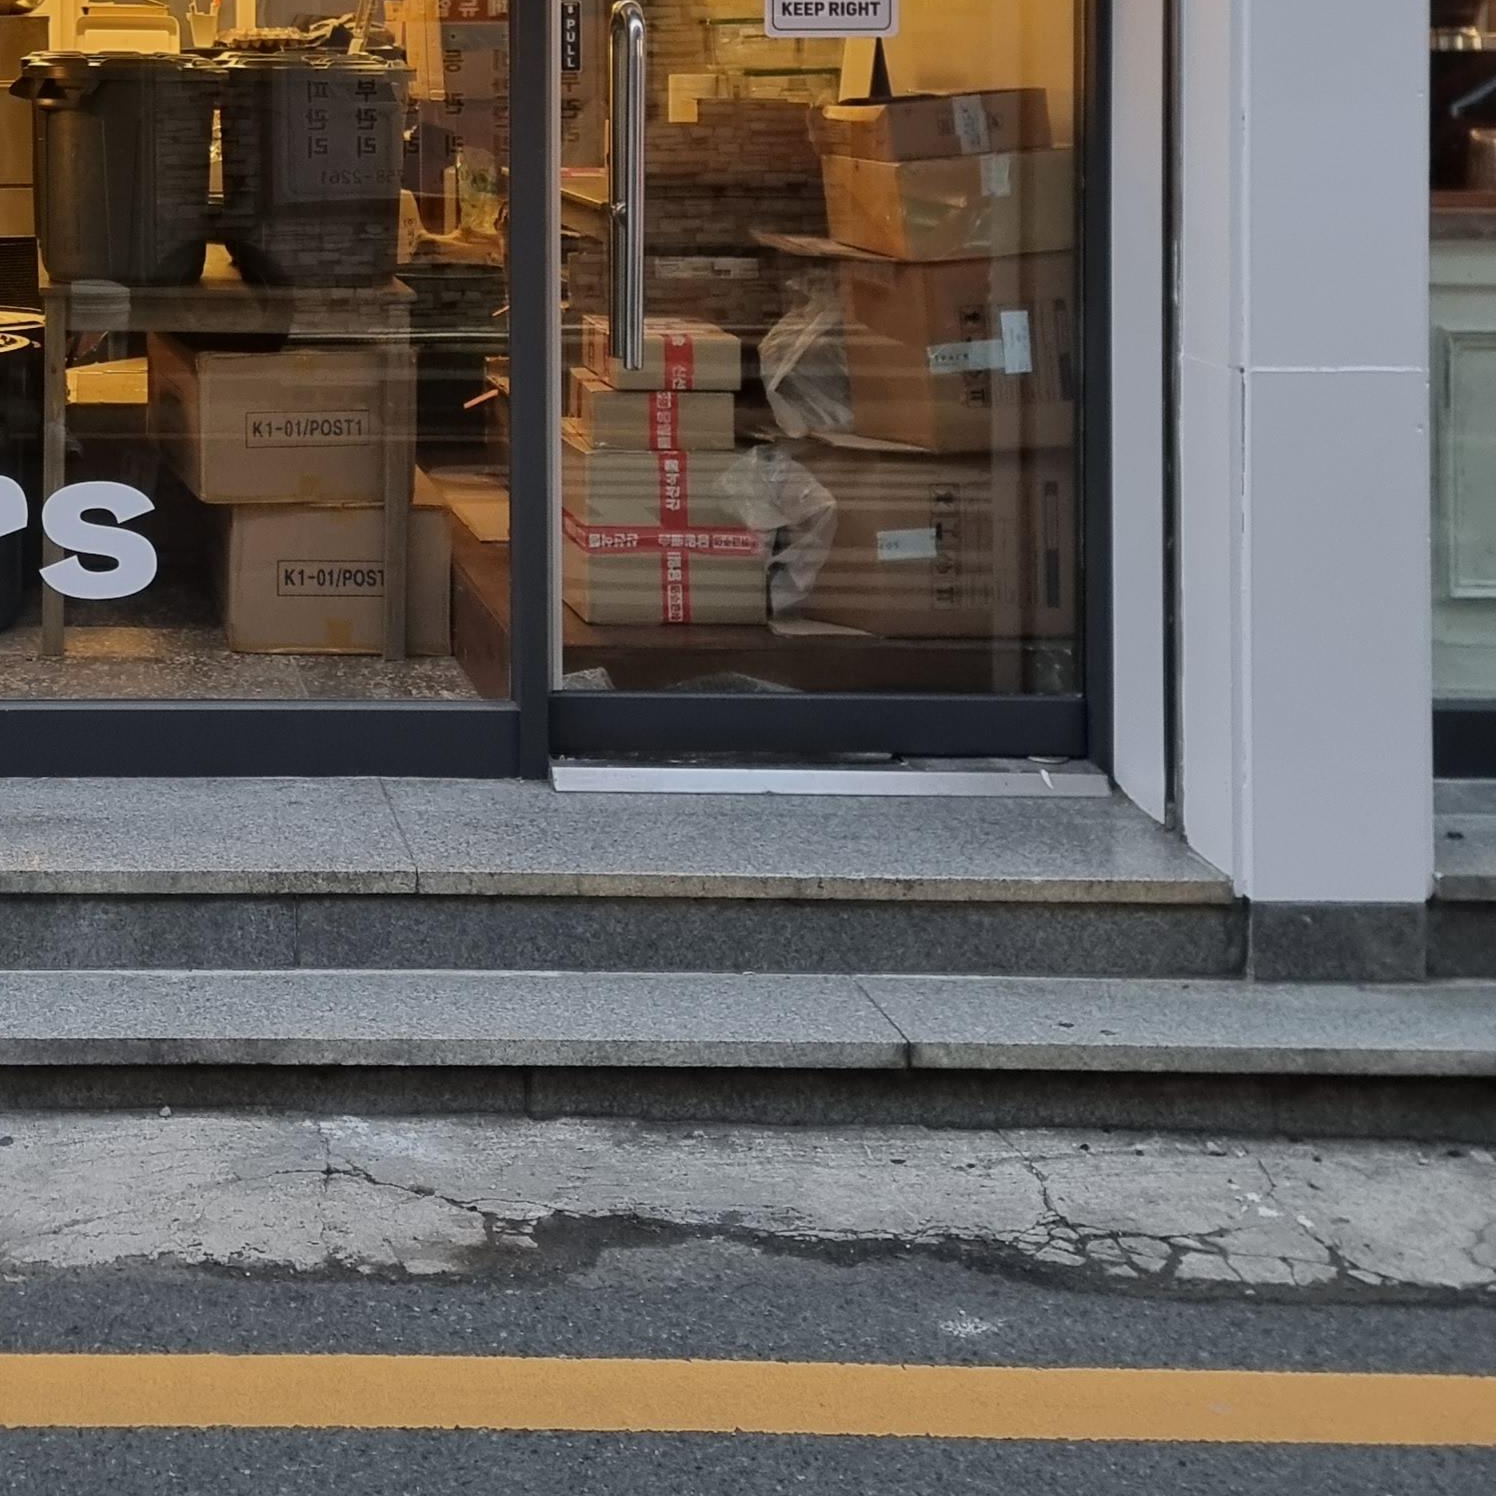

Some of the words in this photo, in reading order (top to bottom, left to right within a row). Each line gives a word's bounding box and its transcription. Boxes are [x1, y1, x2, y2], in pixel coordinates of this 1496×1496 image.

[781, 1, 825, 17] KEEP
[828, 1, 881, 17] RIGHT
[565, 18, 576, 68] PULL
[252, 418, 363, 438] K1-01/POST1
